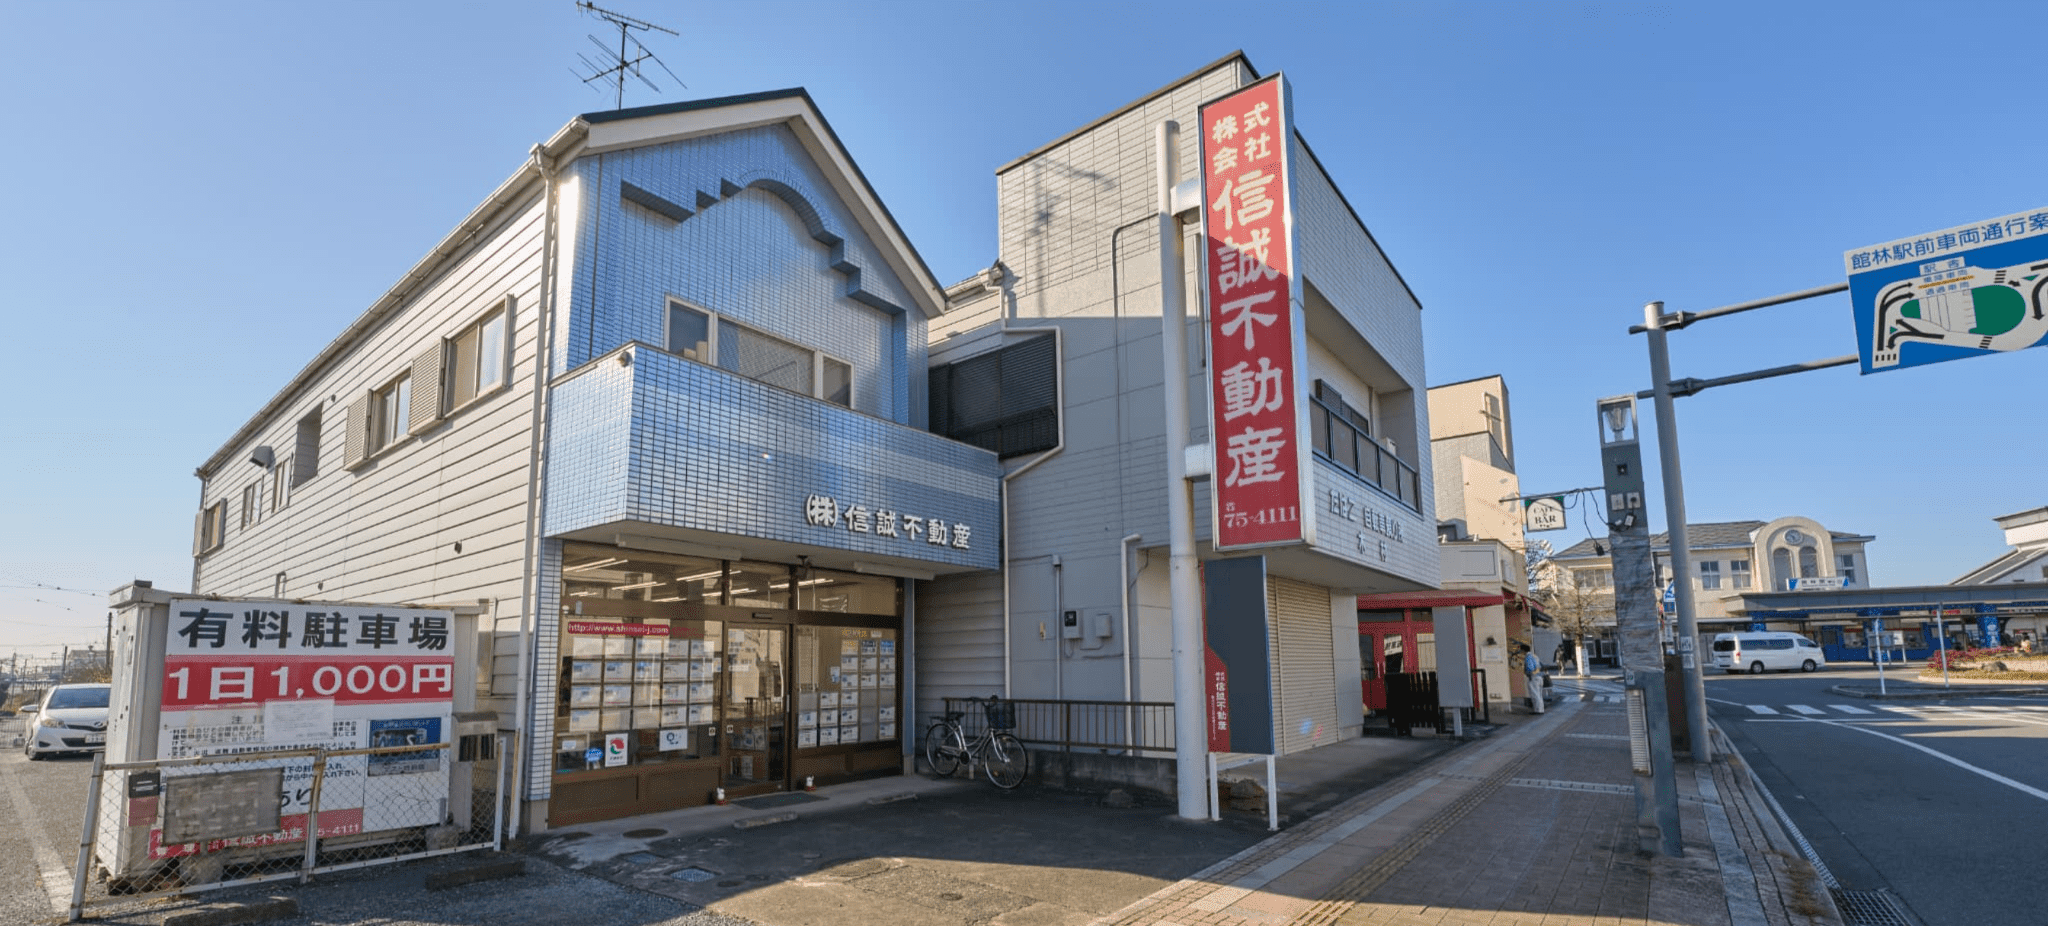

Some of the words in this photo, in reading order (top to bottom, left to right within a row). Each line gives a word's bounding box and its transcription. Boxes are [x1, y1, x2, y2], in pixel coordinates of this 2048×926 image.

[1851, 212, 2048, 270] 館林駅前車両通行案
[1212, 169, 1287, 488] 信誠不動産
[1224, 505, 1298, 528] 75-4111
[1535, 515, 1556, 525] BAR
[178, 608, 449, 650] 有料駐車場
[168, 663, 453, 700] 1日1,000円
